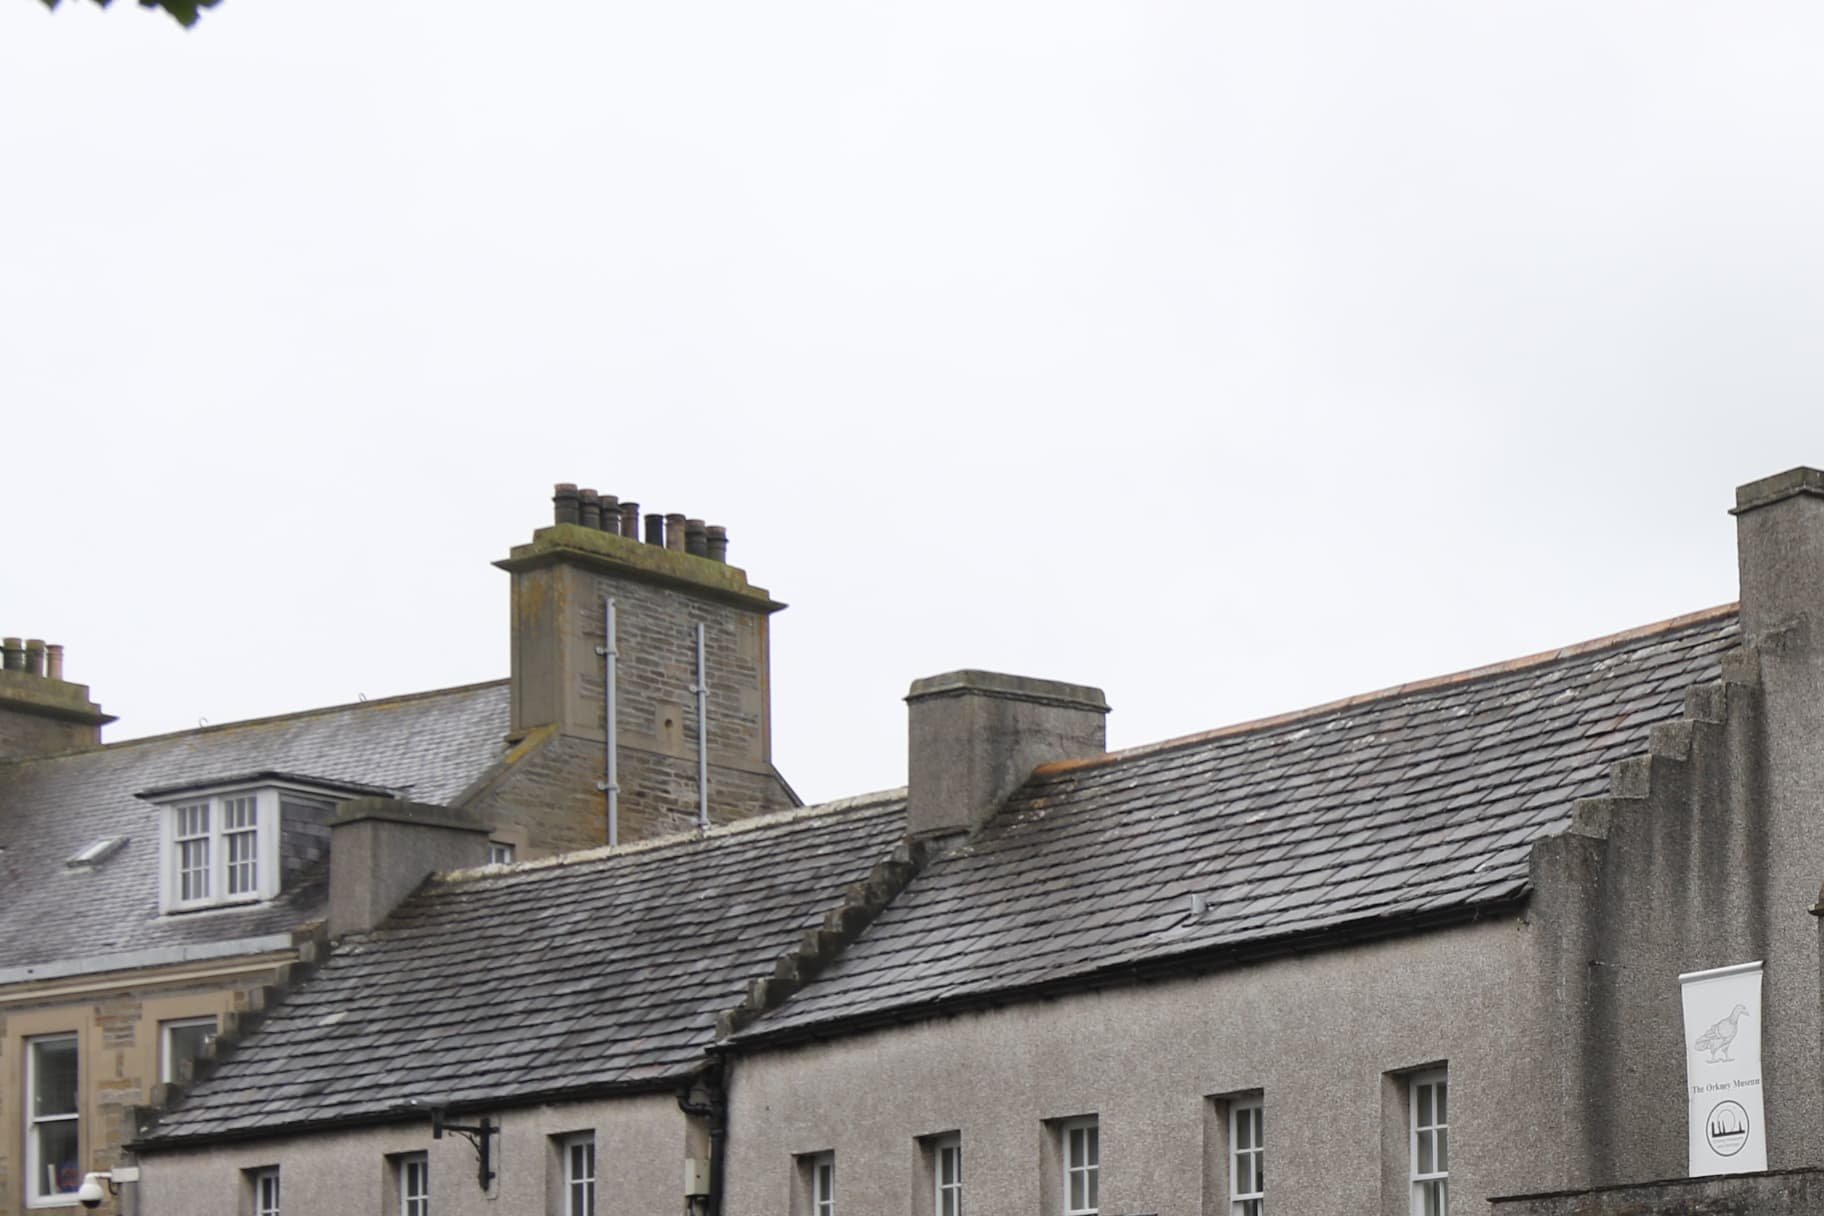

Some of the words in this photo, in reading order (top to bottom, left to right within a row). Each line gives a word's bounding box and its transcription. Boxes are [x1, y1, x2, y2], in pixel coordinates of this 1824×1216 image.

[1692, 1086, 1704, 1094] The
[1706, 1083, 1731, 1092] Orkney
[1733, 1078, 1760, 1088] Museum
